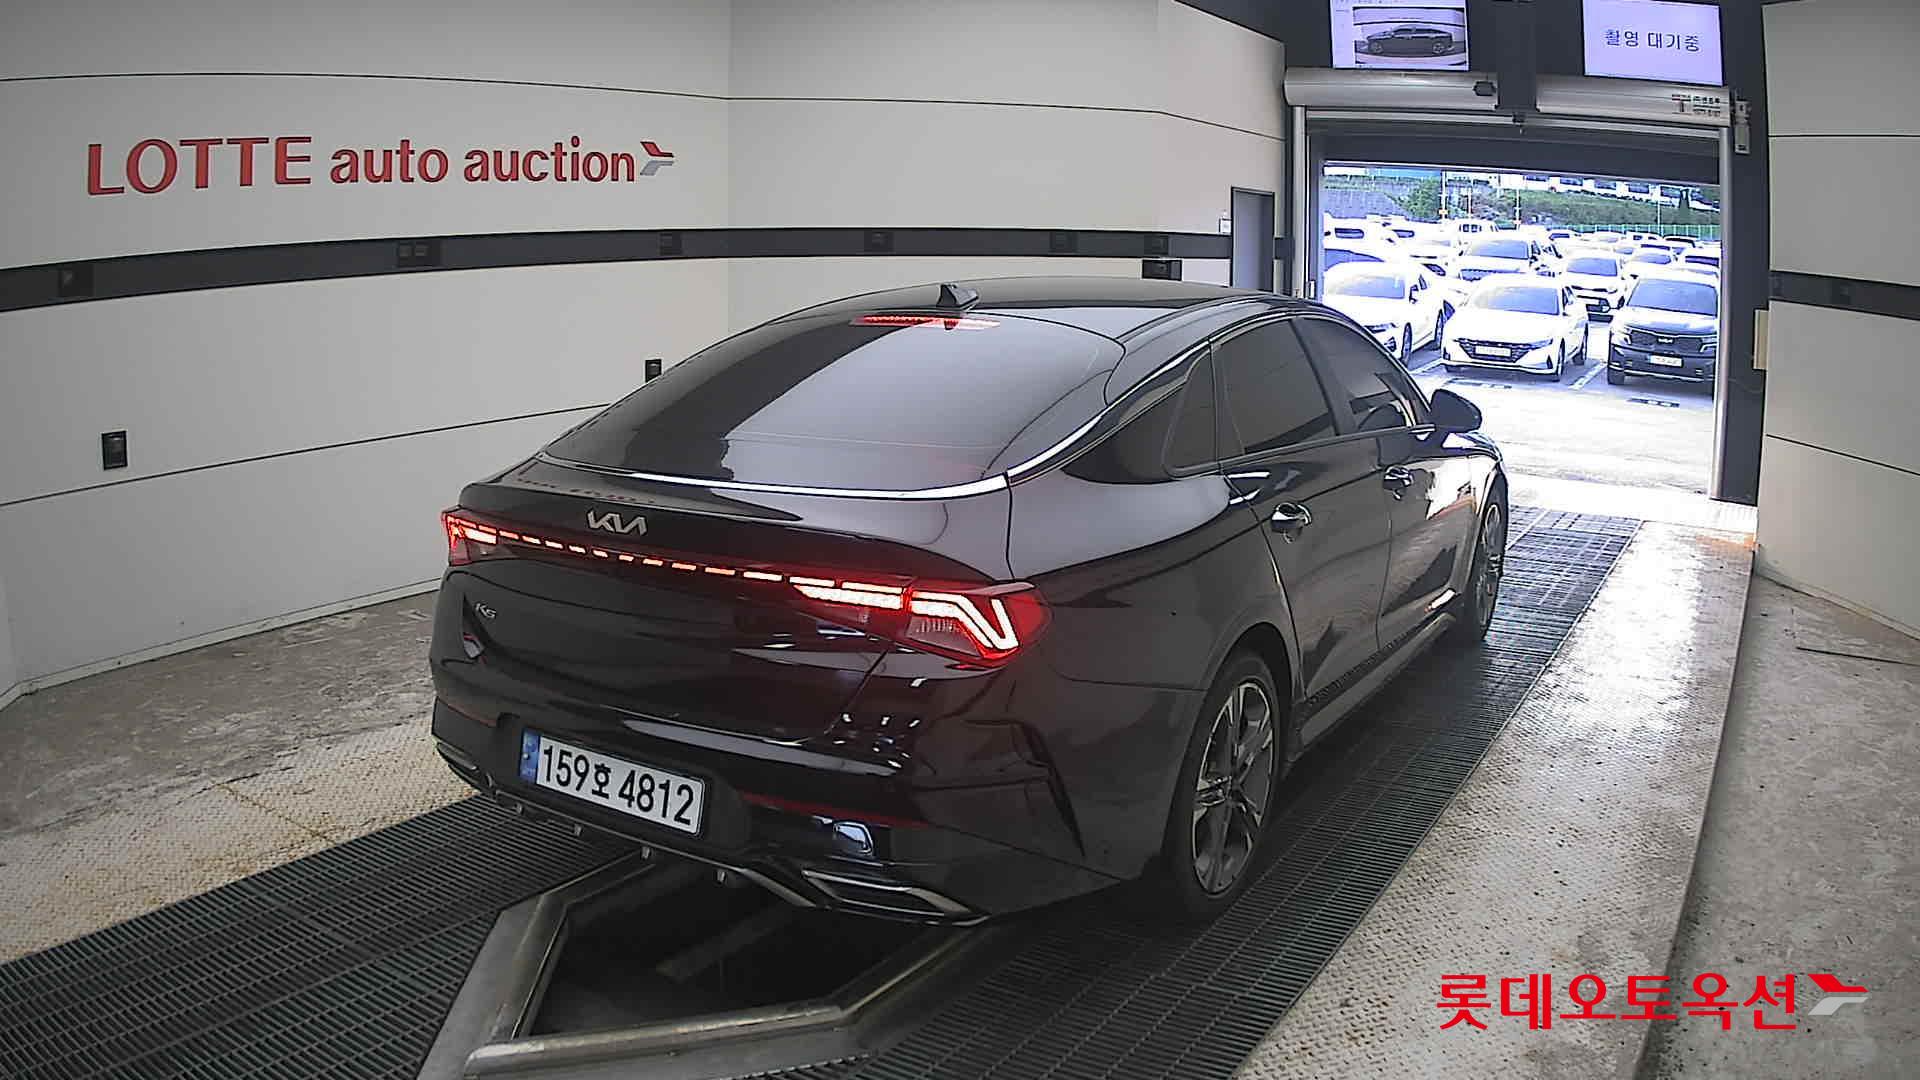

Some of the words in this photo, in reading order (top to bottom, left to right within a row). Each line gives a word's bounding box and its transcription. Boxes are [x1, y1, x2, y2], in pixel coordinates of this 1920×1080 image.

[1647, 32, 1699, 52] 대기중
[87, 136, 312, 196] LOTTE
[330, 139, 449, 184] auto
[464, 135, 636, 183] auction
[587, 508, 648, 536] KIA
[543, 745, 612, 800] 159호
[618, 769, 694, 826] 4812
